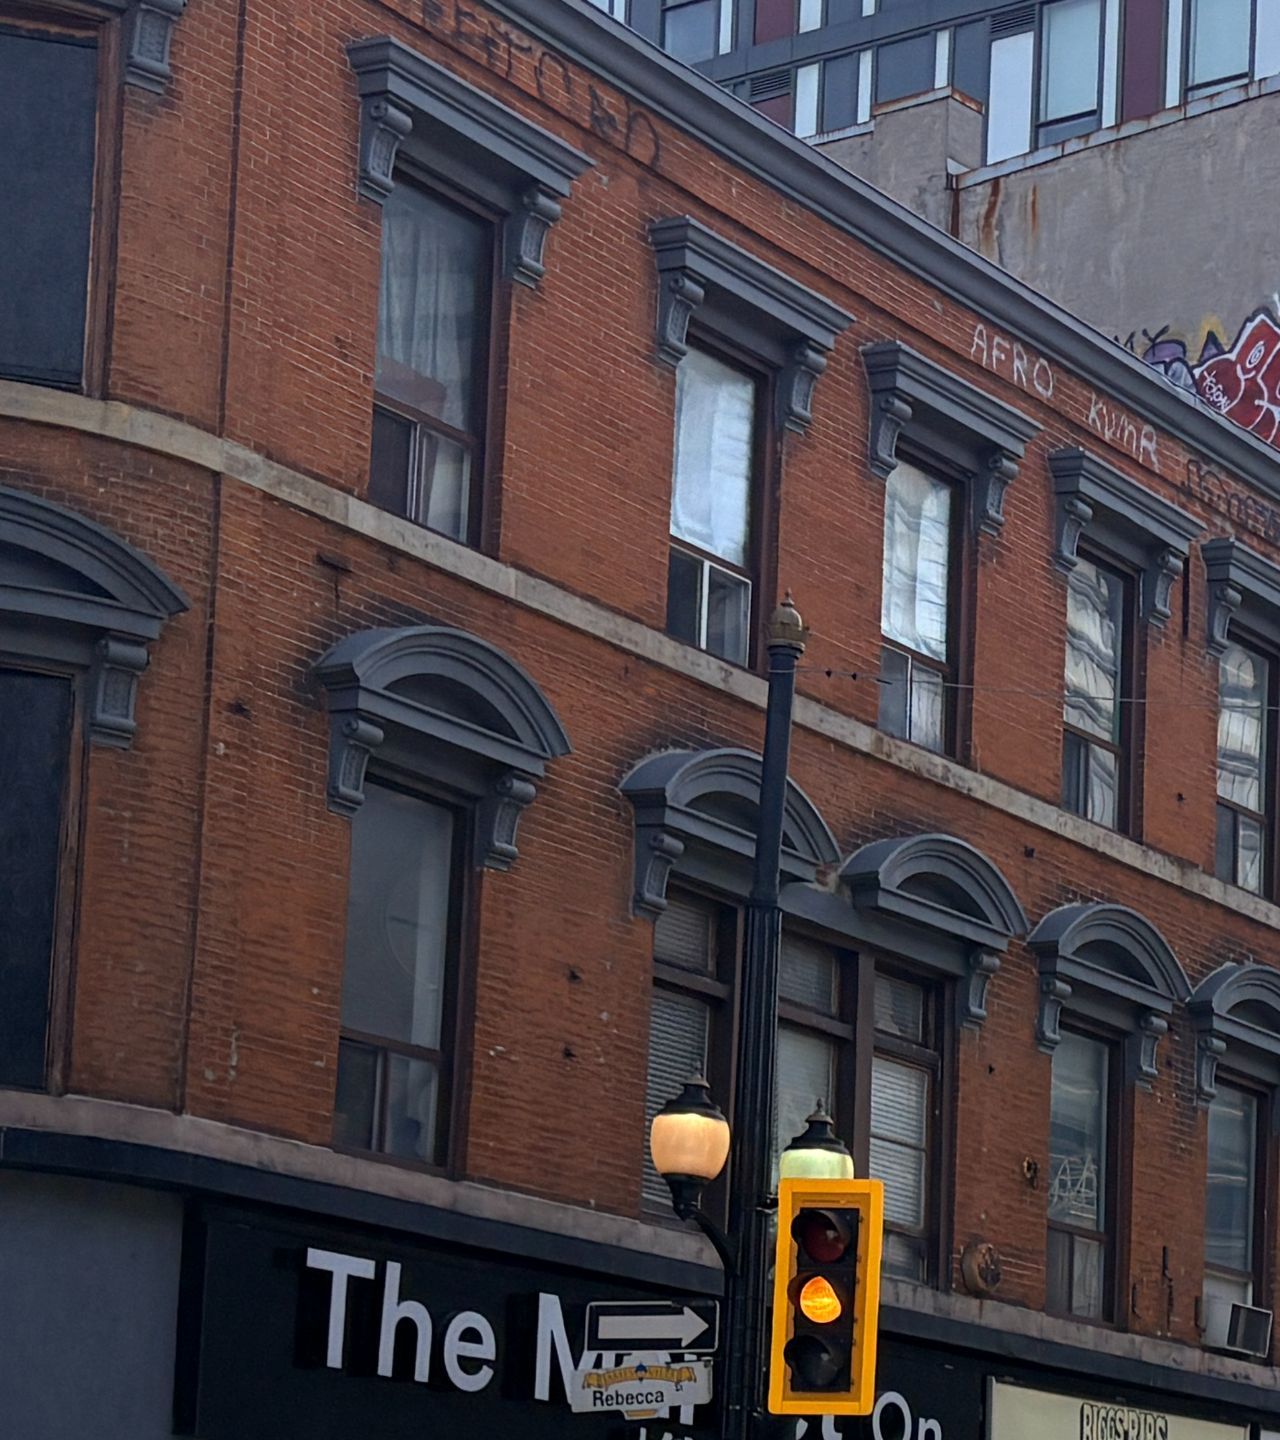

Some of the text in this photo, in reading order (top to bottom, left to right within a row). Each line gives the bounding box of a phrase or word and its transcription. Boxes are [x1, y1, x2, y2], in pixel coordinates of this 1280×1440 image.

[970, 323, 1055, 399] AFRO
[306, 1247, 497, 1393] The
[592, 1388, 665, 1408] Rebecca
